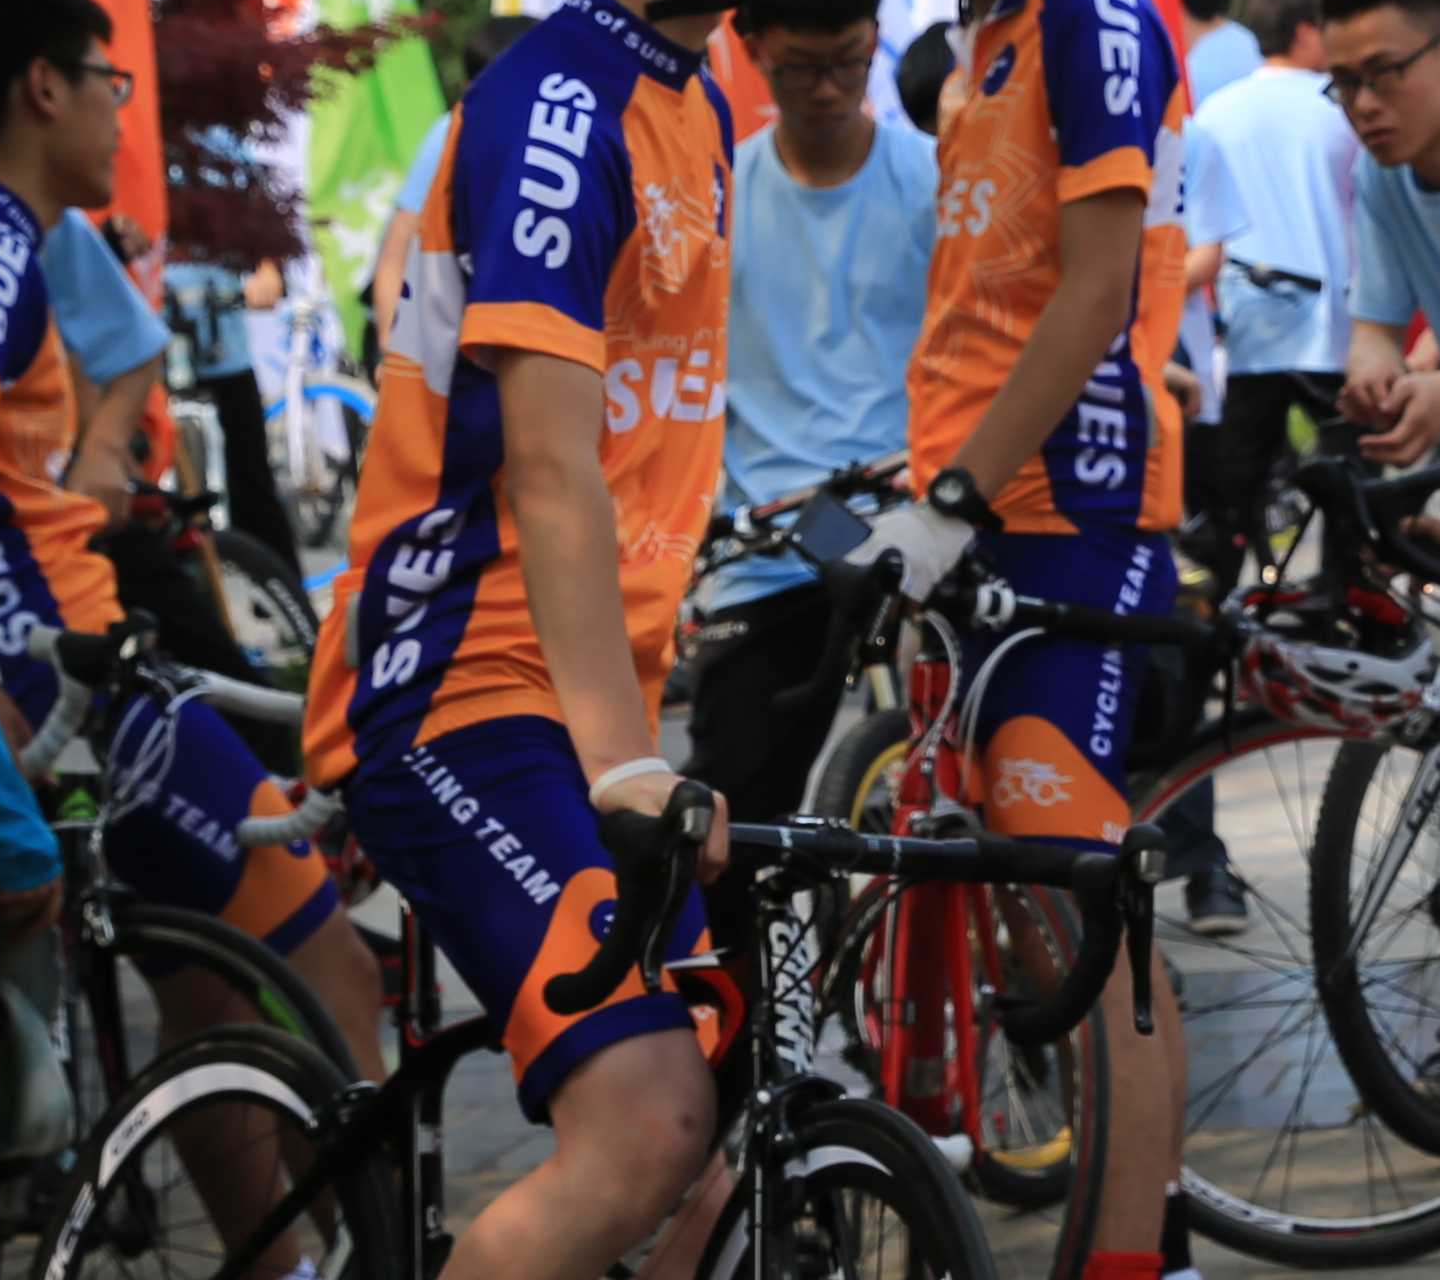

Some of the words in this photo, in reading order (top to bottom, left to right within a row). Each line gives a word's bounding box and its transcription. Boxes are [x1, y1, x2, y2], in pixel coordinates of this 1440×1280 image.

[513, 72, 597, 270] SUES
[606, 357, 726, 435] SUE
[474, 817, 561, 905] TEAM
